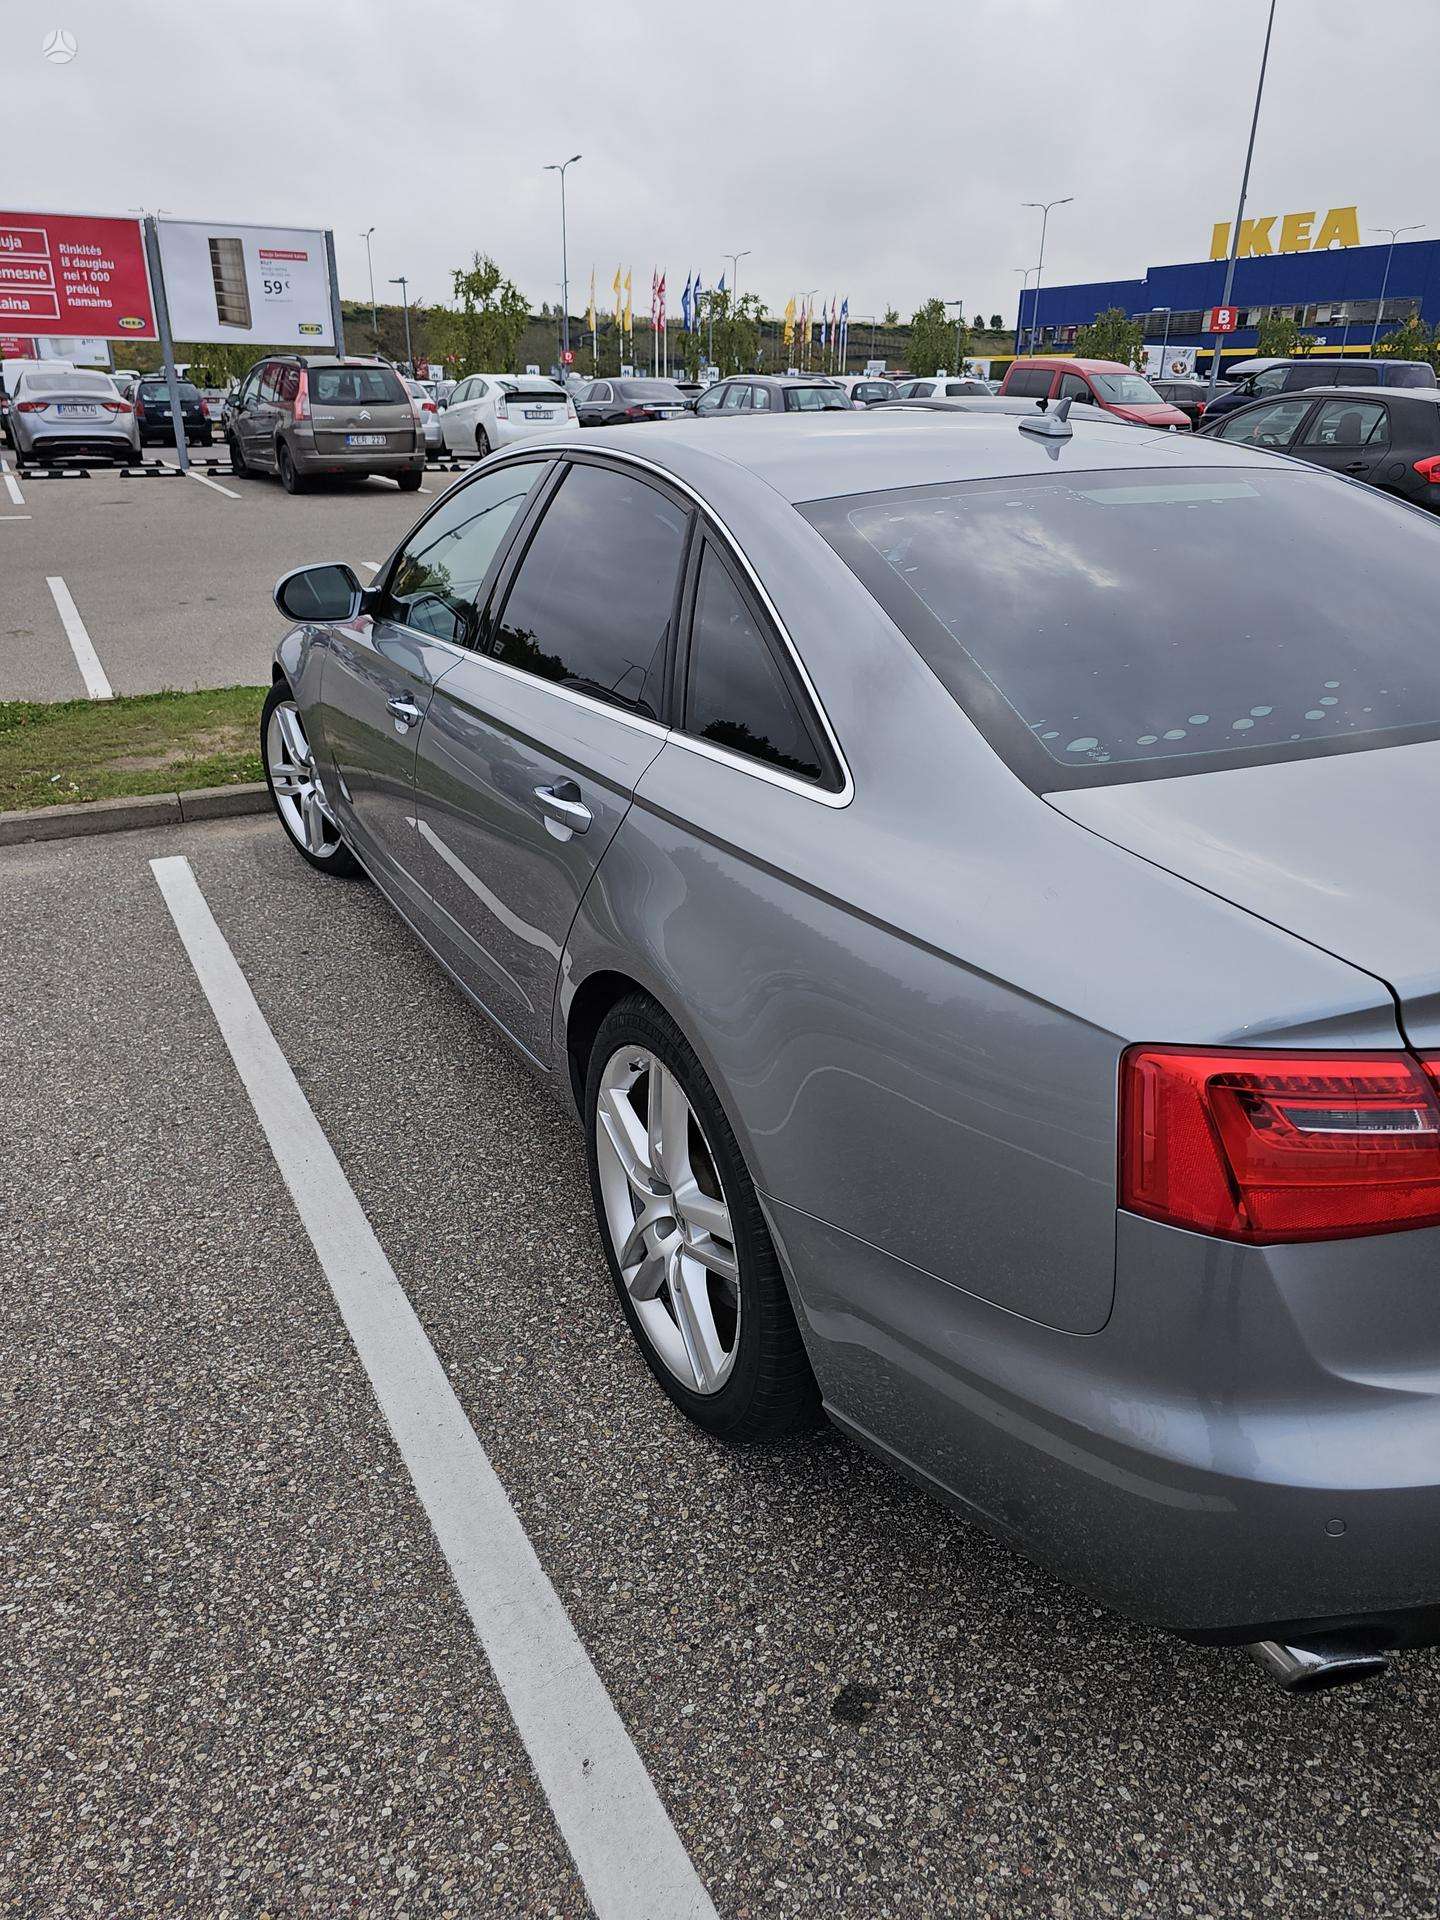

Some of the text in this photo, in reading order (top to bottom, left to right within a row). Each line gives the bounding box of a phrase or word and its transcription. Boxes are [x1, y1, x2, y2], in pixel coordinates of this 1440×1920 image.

[1209, 206, 1360, 260] IKEA
[0, 234, 22, 251] uja
[59, 243, 102, 256] Rinkitės
[72, 258, 115, 271] daugiau
[63, 270, 110, 282] nei 1 000
[66, 284, 101, 297] prekių
[264, 280, 283, 294] 59
[0, 296, 31, 311] aina
[67, 297, 113, 308] namams
[1218, 309, 1230, 325] B
[565, 352, 573, 361] D
